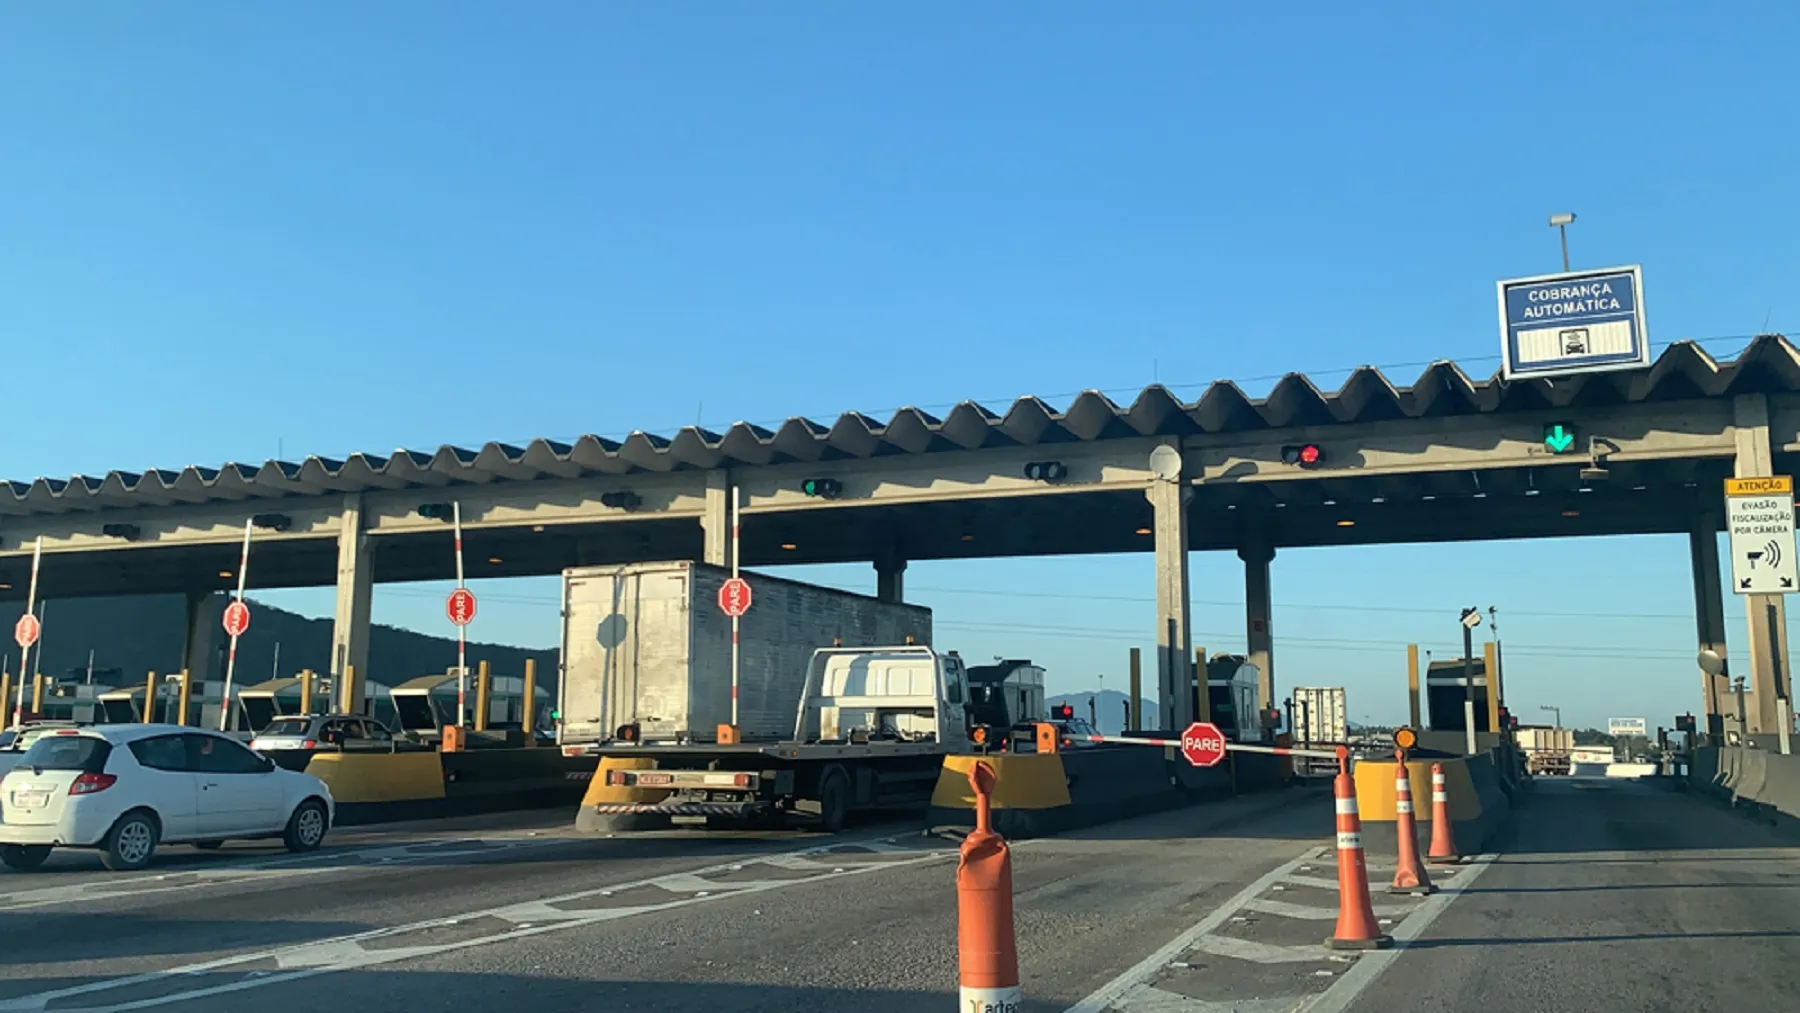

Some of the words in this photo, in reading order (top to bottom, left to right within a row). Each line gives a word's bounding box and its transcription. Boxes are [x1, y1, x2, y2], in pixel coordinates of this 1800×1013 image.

[1528, 283, 1612, 302] COBRANÇA
[1524, 298, 1620, 318] AUTOMÁTICA
[1737, 480, 1782, 492] ATENÇÃO
[1741, 500, 1777, 510] EVASÃO
[1732, 511, 1791, 523] FISCALIZAÇÃO
[1734, 526, 1751, 534] POR
[729, 582, 741, 615] PARE
[456, 593, 465, 622] PARE
[1185, 737, 1220, 752] PARE
